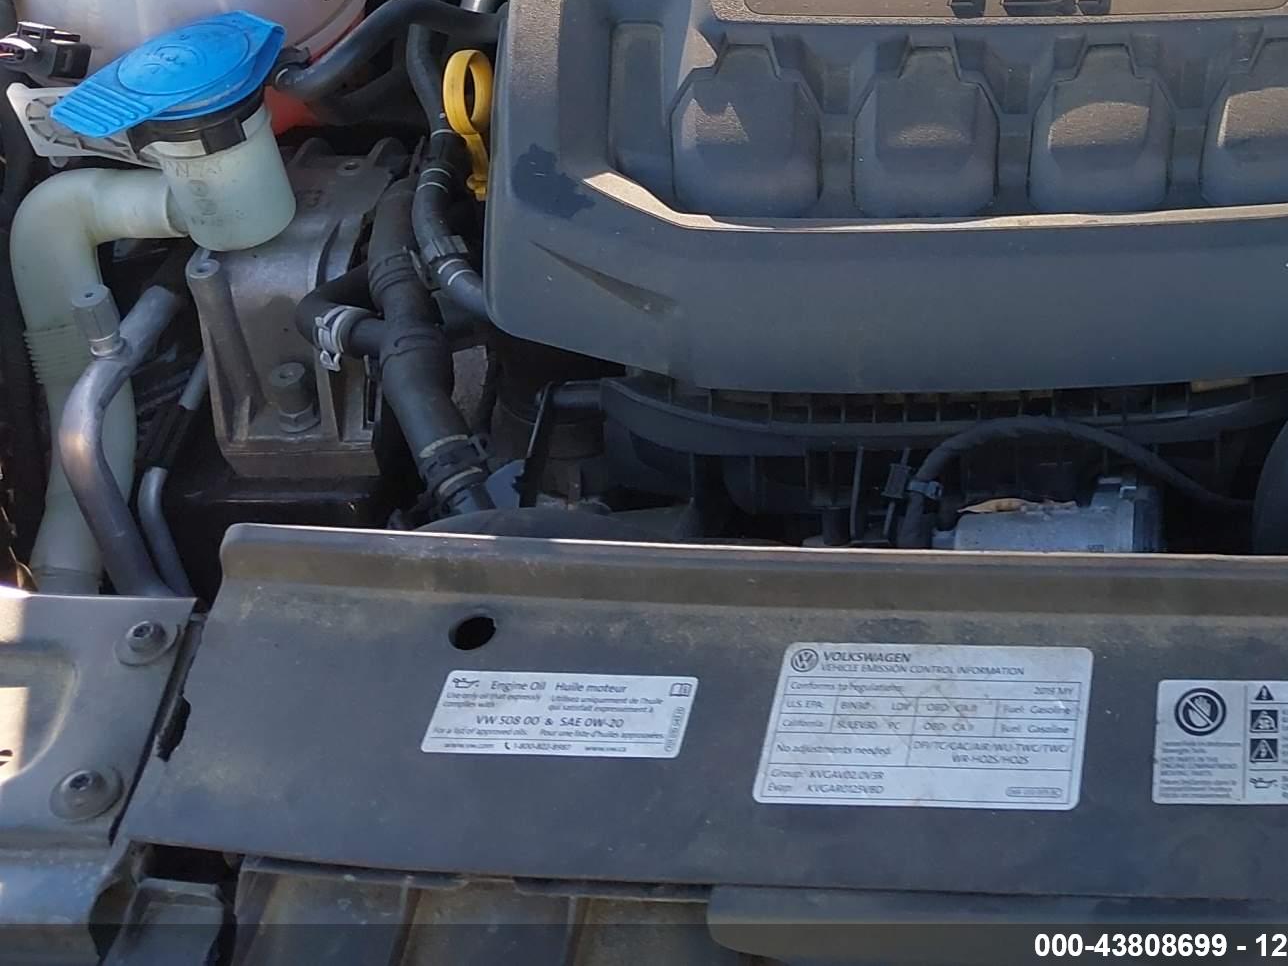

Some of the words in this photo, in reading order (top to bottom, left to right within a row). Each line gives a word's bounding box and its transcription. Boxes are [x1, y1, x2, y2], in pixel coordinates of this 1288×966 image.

[823, 651, 911, 663] VOLKSWAGEN
[861, 664, 908, 673] EMISSION
[910, 665, 953, 674] CONTROL
[958, 666, 1024, 675] INFORMATION
[490, 681, 528, 693] Engine
[529, 681, 547, 691] Oil
[555, 682, 584, 692] Huile
[586, 684, 628, 694] moteur
[476, 715, 498, 725] VW
[499, 715, 521, 725] 508
[523, 715, 541, 726] 00
[560, 716, 582, 726] SAE
[584, 717, 625, 728] 0W-20
